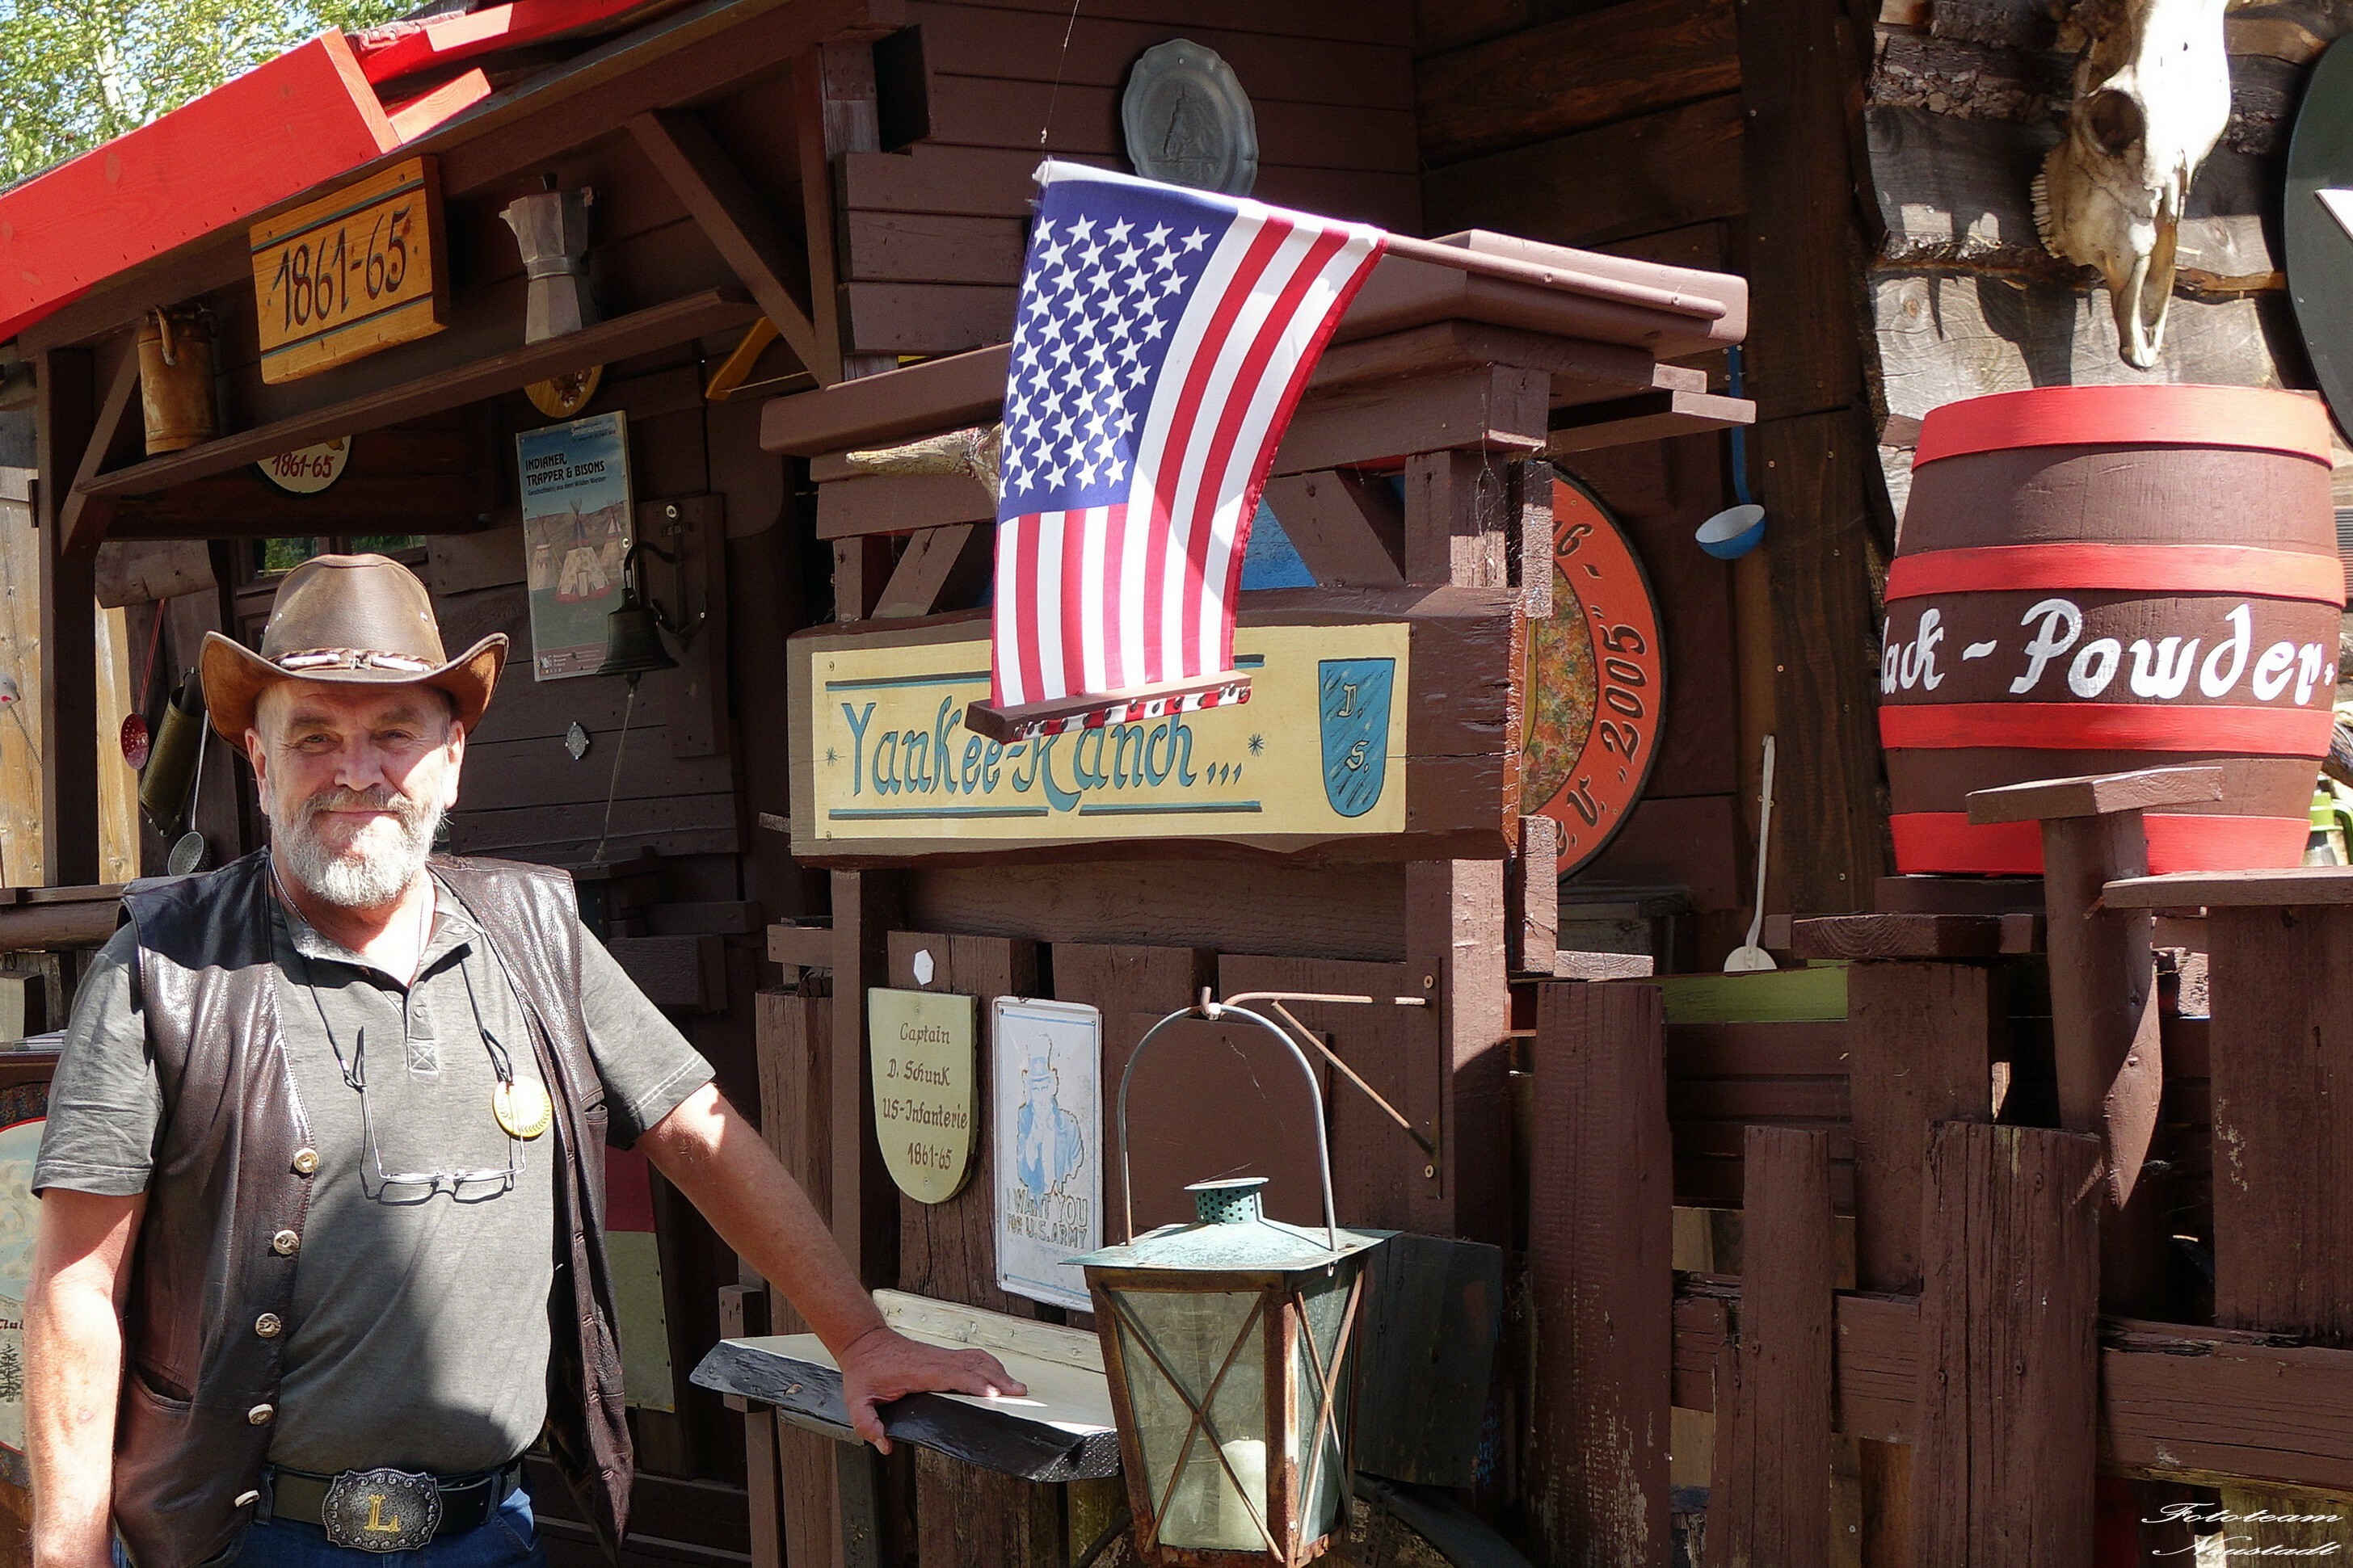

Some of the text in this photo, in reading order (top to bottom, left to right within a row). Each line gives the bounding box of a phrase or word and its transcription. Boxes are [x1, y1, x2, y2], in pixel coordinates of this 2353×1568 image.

[272, 204, 410, 332] 1861-65
[272, 452, 335, 478] 1861-65
[526, 460, 605, 486] TRAPPER & BISONS
[1881, 608, 1946, 695] lack
[2009, 599, 2323, 706] Powder
[899, 1022, 950, 1047] Captain
[887, 1058, 899, 1078] D.
[882, 1097, 968, 1130] US-Infanterie
[907, 1142, 953, 1170] 1861-65
[1012, 1188, 1051, 1220] WANT
[1055, 1193, 1088, 1227] YOU
[1007, 1213, 1023, 1236] FOR
[364, 1494, 402, 1532] L
